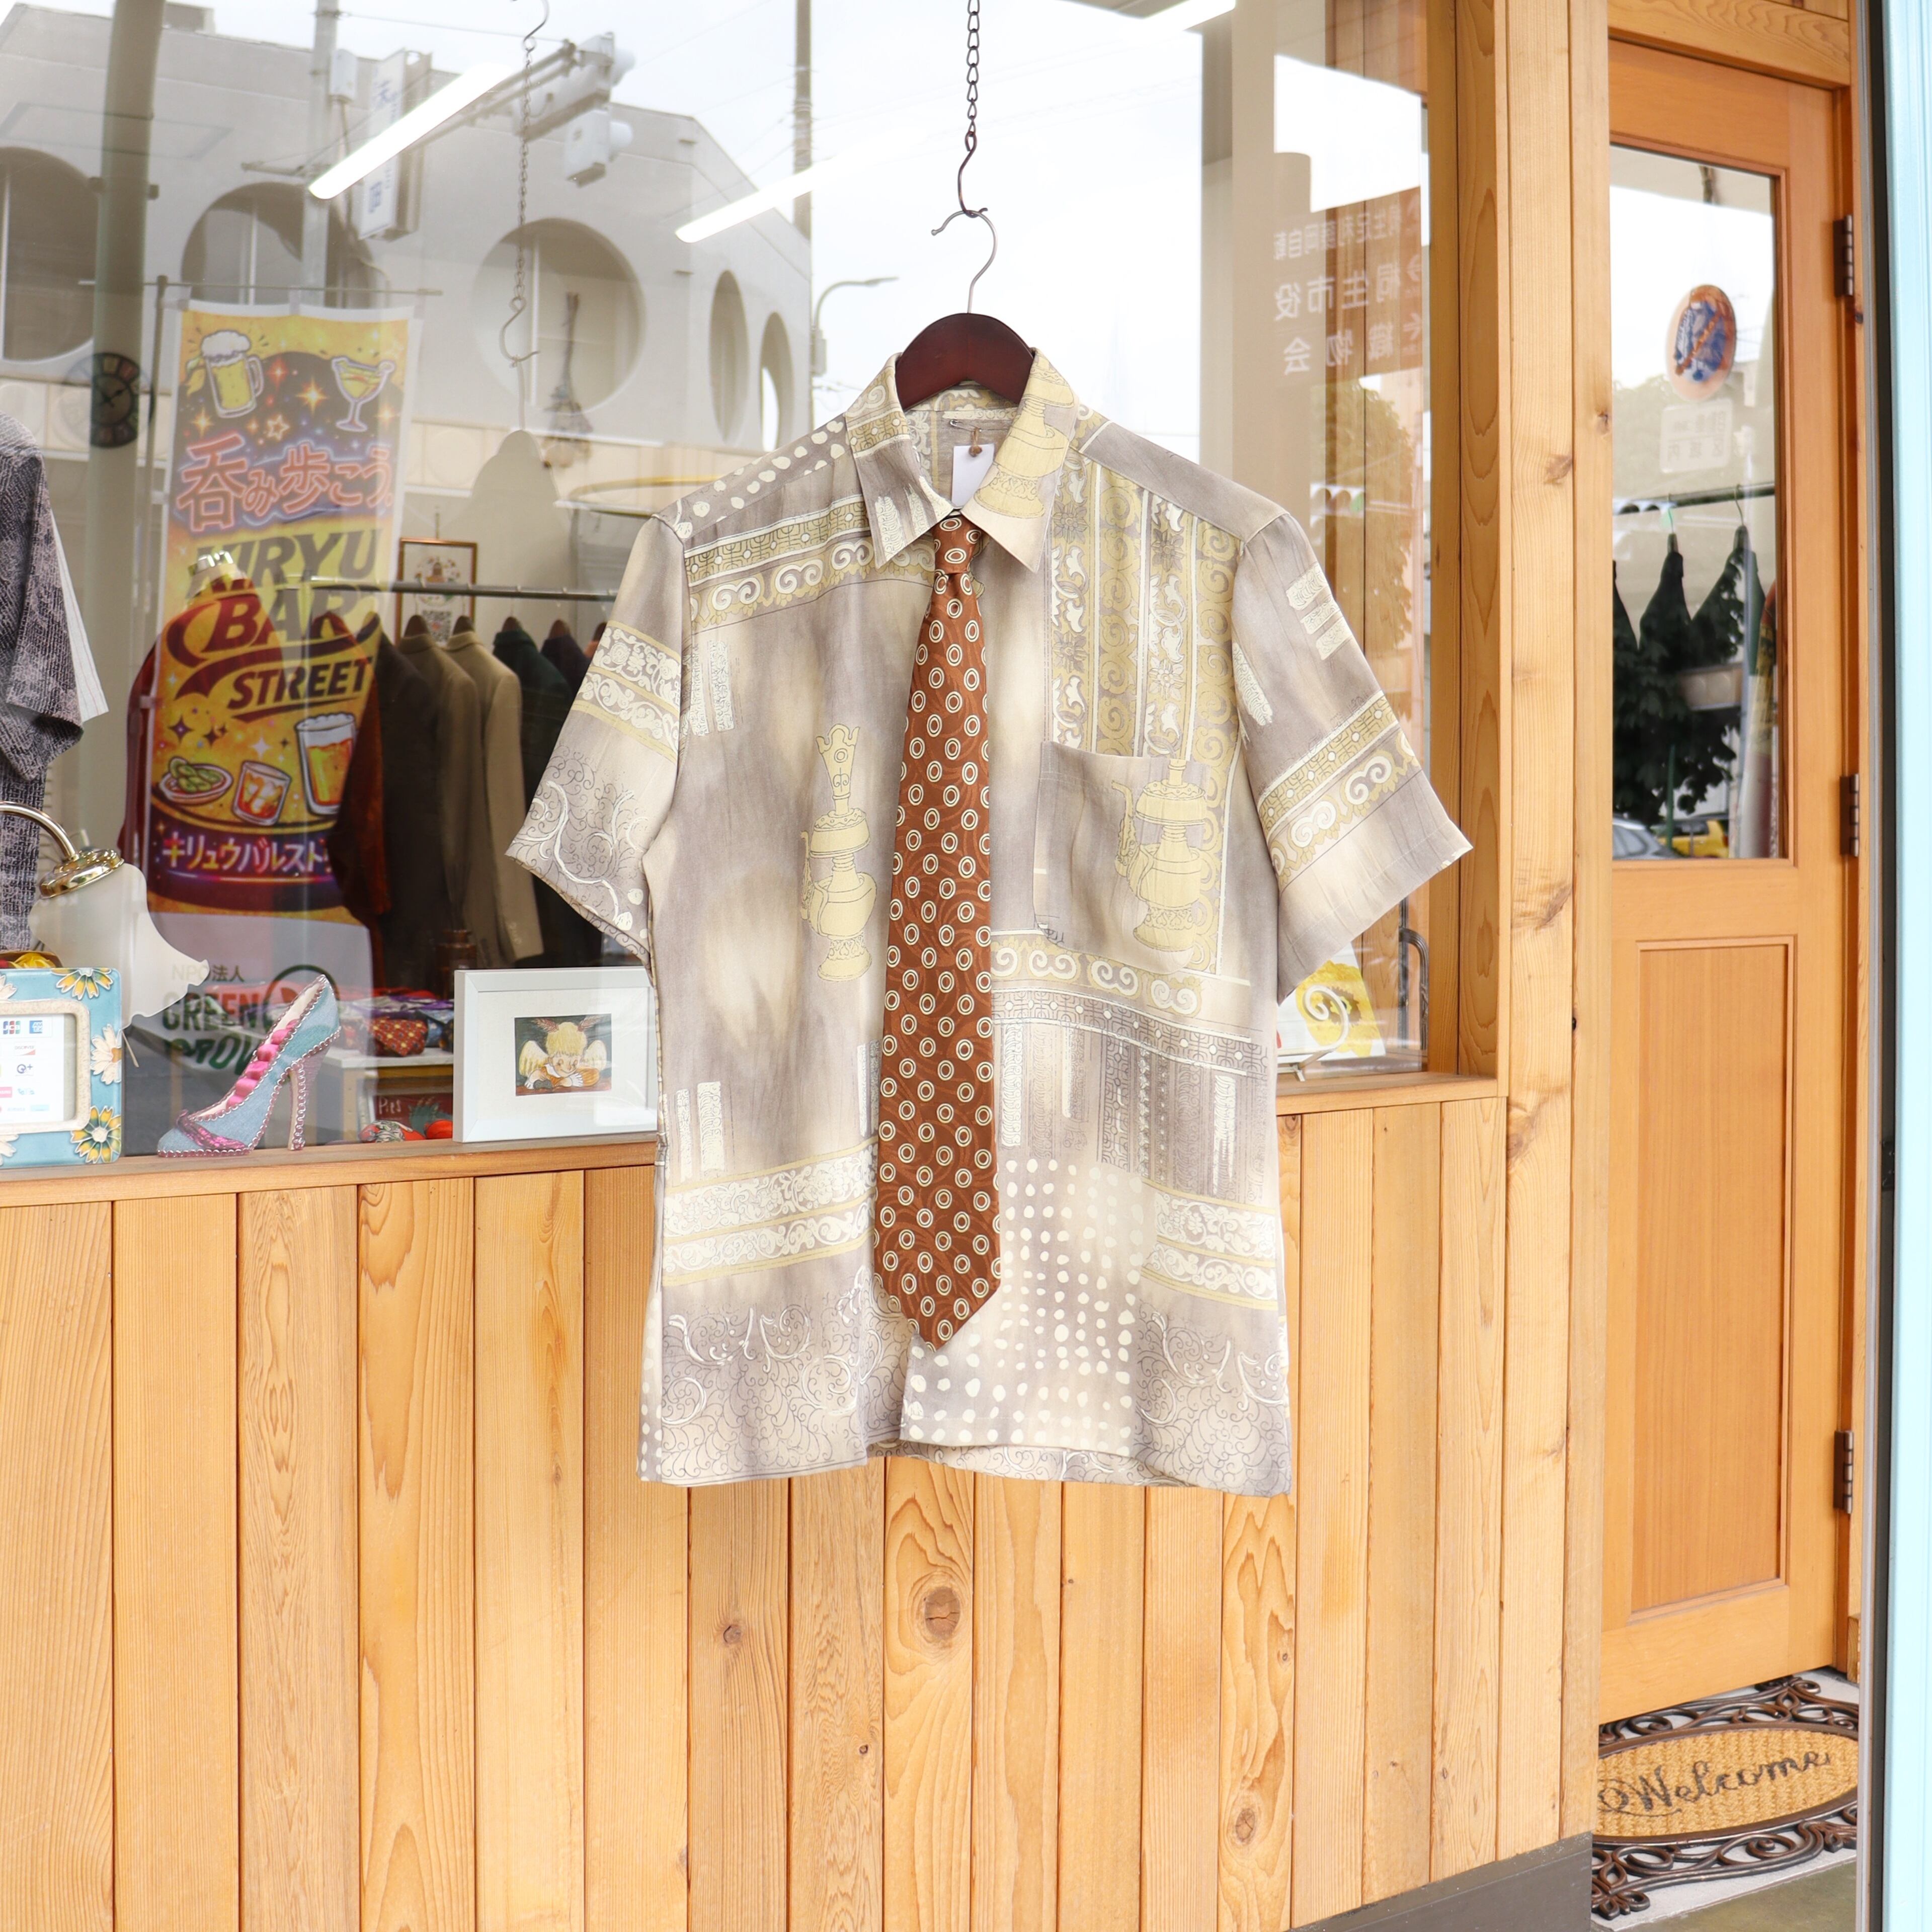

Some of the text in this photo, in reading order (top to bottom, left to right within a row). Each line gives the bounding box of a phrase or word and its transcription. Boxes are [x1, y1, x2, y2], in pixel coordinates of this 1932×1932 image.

[202, 585, 363, 653] BAR
[227, 657, 373, 709] STREET
[163, 992, 260, 1031] GREEN
[1598, 1750, 1831, 1817] Welcome
